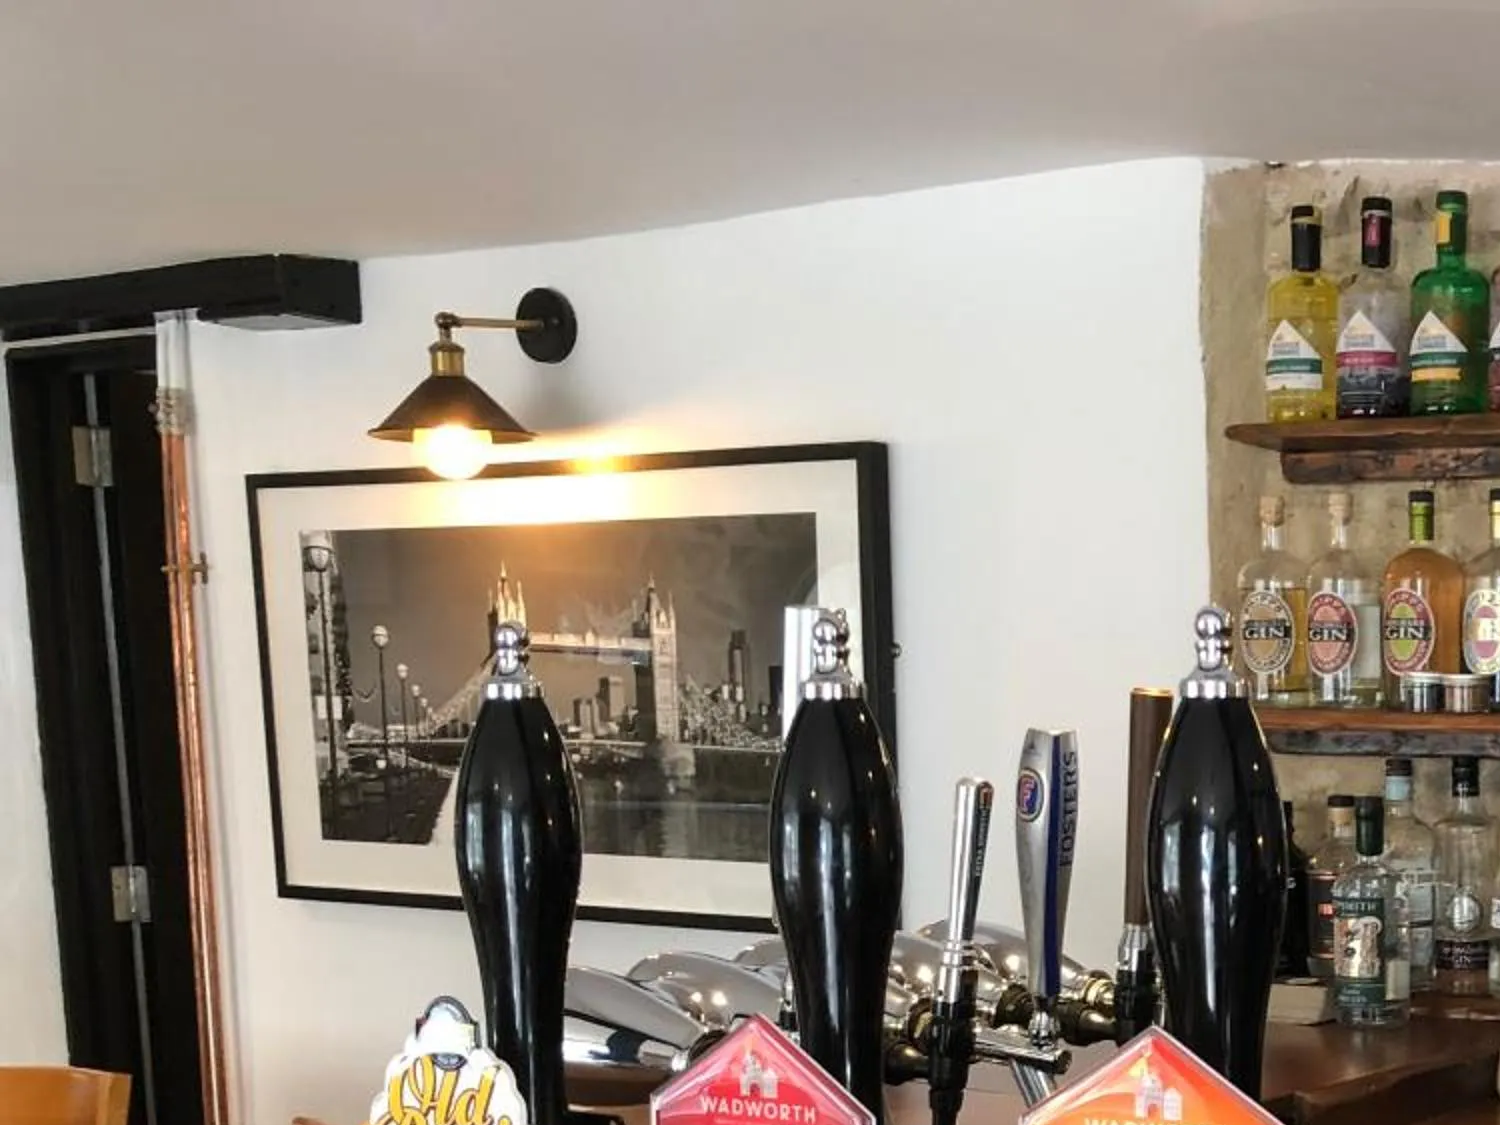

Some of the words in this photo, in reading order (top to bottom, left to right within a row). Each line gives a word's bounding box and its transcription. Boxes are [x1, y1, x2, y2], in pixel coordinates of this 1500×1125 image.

[1245, 626, 1285, 639] GIN
[1309, 628, 1348, 641] GIN
[1386, 626, 1425, 640] GIN
[701, 1095, 817, 1124] WADWORTH
